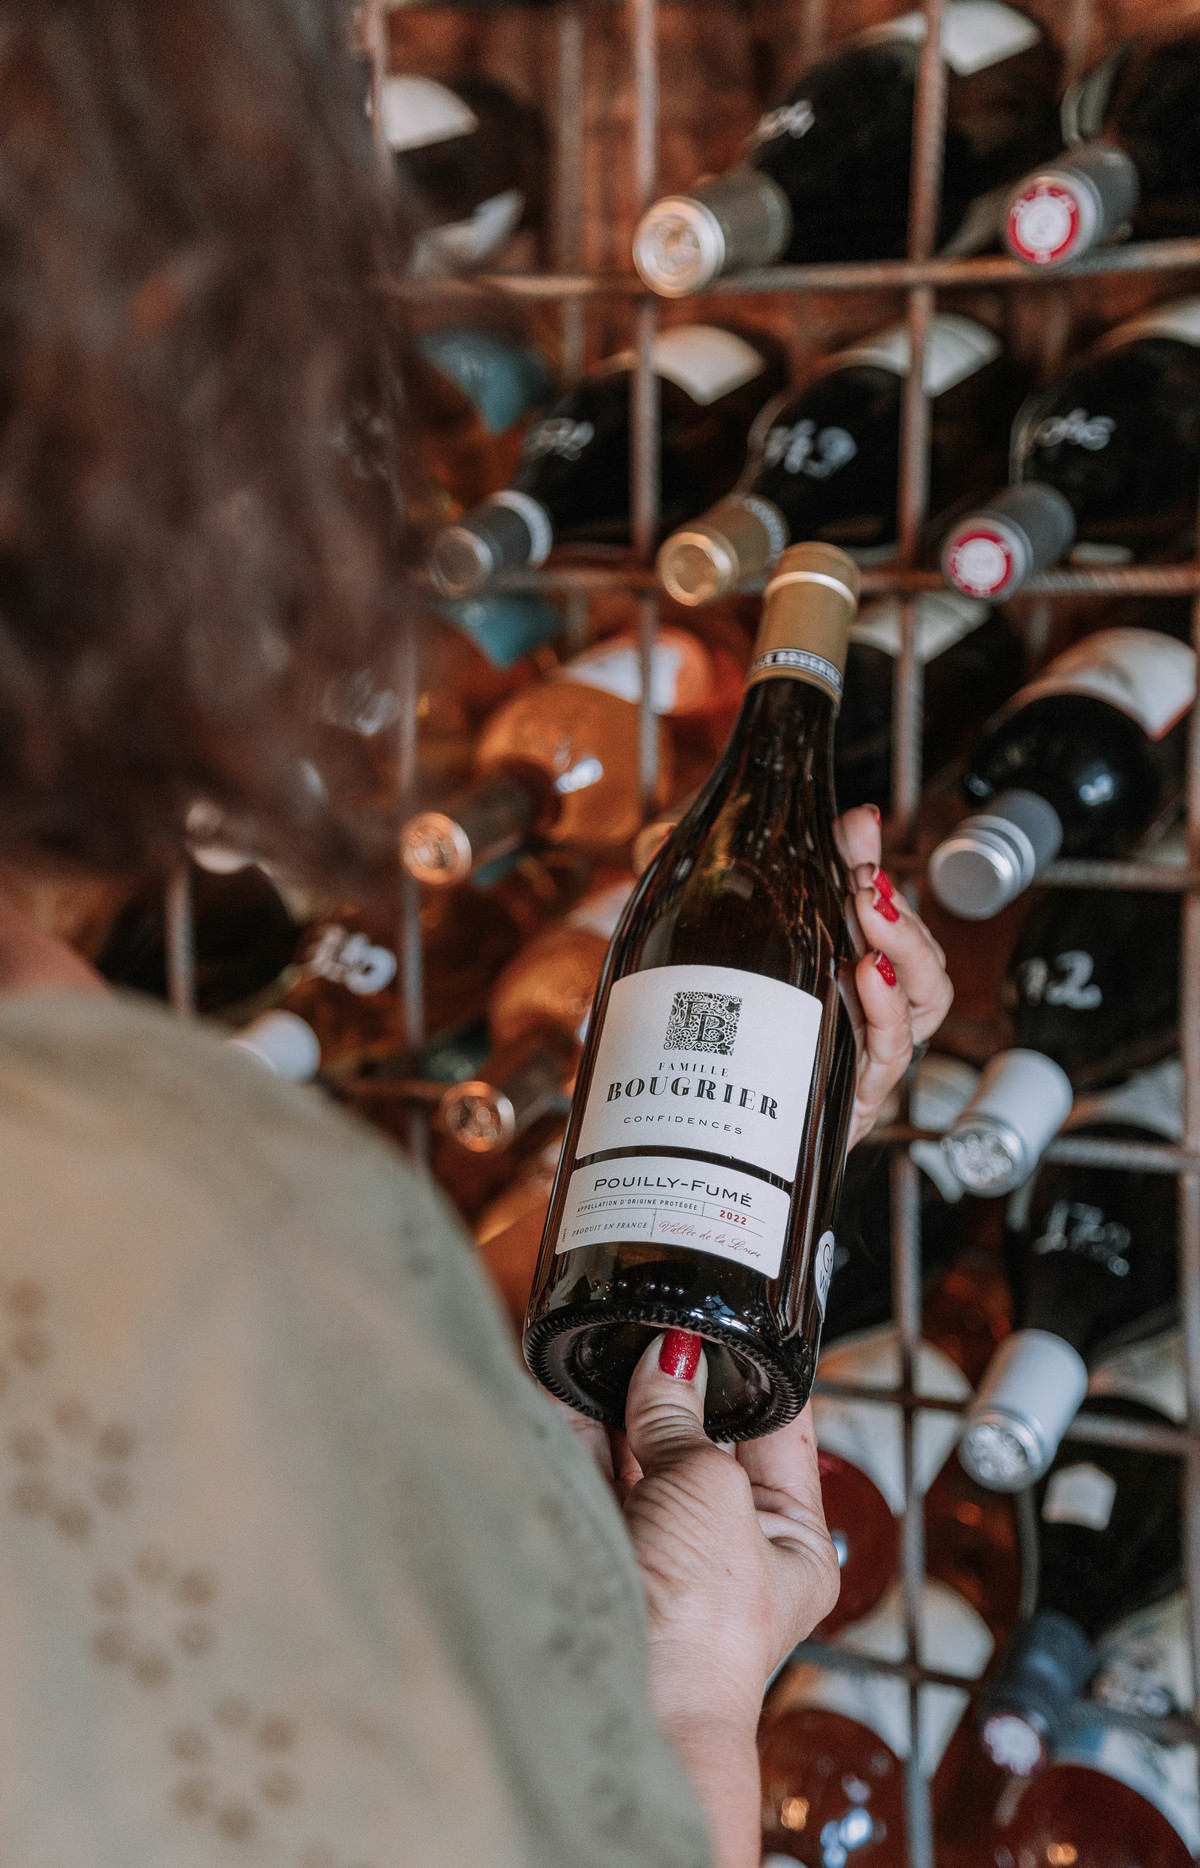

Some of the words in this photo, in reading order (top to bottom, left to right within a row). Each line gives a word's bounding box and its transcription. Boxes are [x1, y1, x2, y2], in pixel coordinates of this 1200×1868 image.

[657, 1062, 729, 1077] FAMILLE
[605, 1076, 778, 1120] BOUGRIER
[623, 1115, 743, 1135] CONFIDENCES
[593, 1176, 753, 1208] POUILLY-FUMÉ
[576, 1199, 618, 1213] APPELLATION
[619, 1198, 657, 1206] D'ORIGINE
[659, 1199, 698, 1211] PROTÉGÉE
[719, 1209, 747, 1226] 2022
[571, 1224, 602, 1238] PRODUIT
[603, 1222, 613, 1231] EN
[616, 1222, 648, 1230] FRANCE
[658, 1221, 697, 1237] Vallée
[698, 1229, 712, 1241] de
[714, 1234, 726, 1248] la
[727, 1237, 762, 1260] Loire
